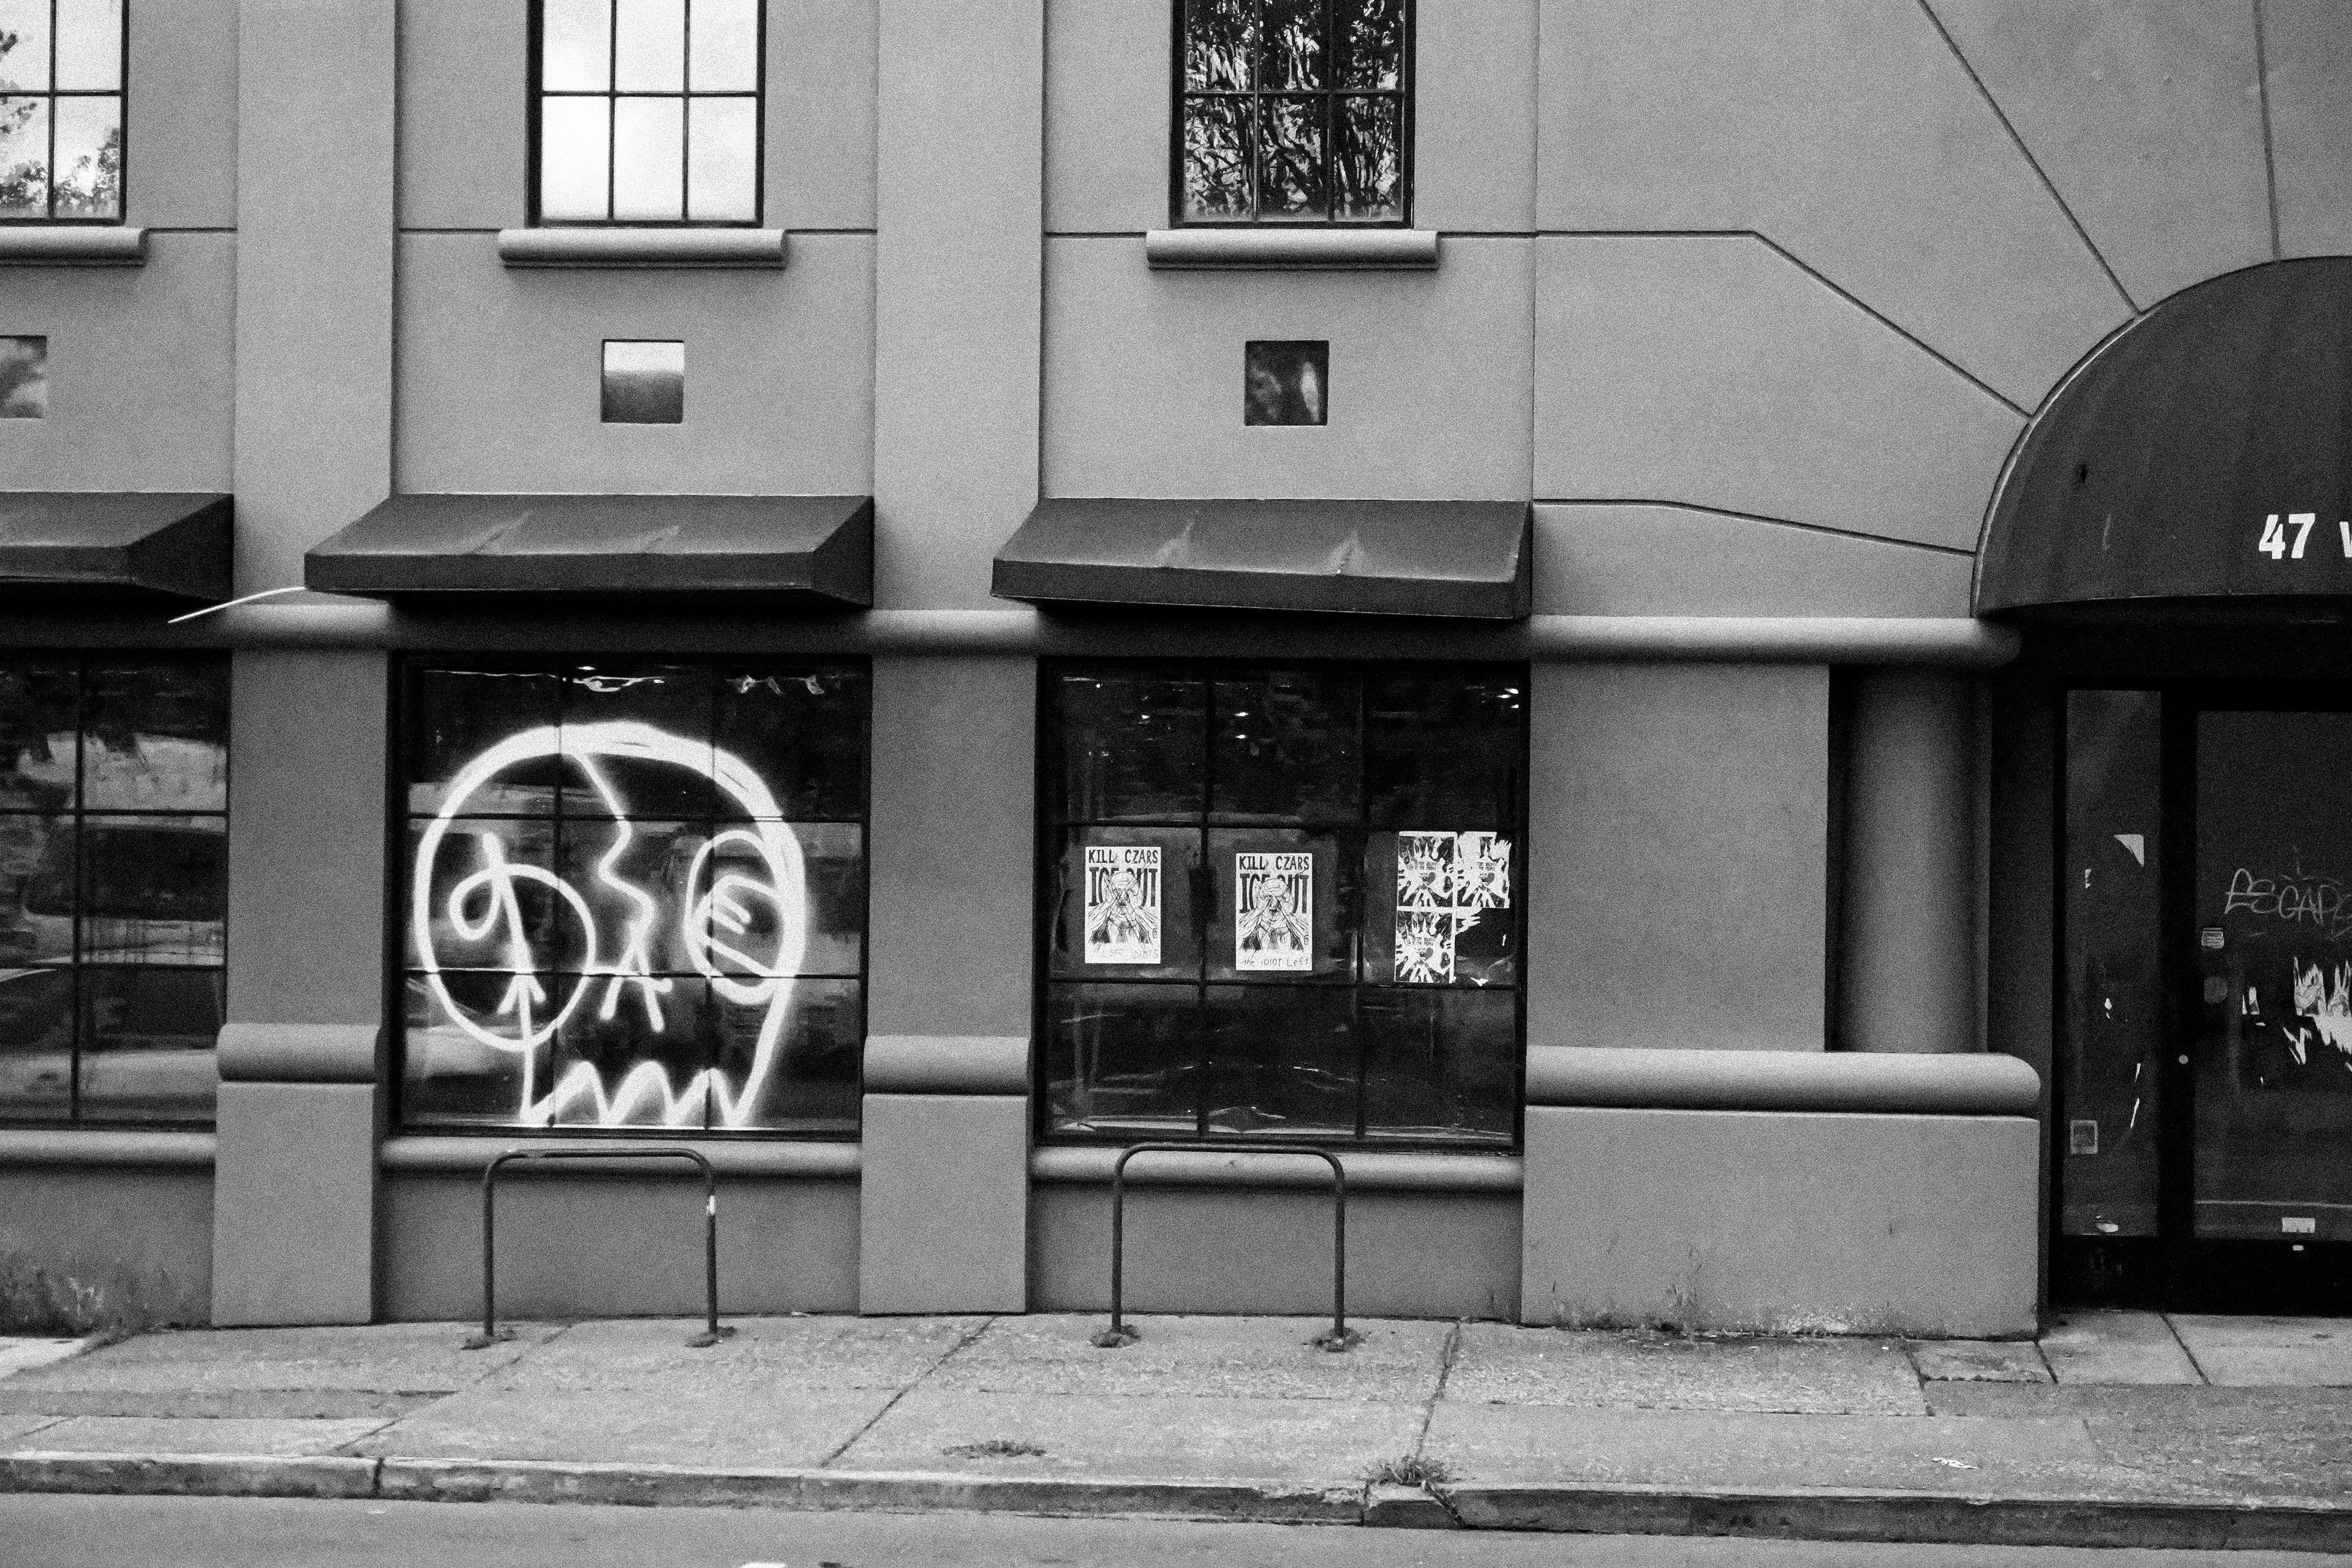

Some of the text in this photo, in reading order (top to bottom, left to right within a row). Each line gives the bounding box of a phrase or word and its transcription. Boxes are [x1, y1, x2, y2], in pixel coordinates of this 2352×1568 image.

[2259, 513, 2315, 559] 47
[1088, 849, 1158, 864] KILL CZARS
[1239, 856, 1310, 870] KILL CZARS
[1126, 867, 1158, 907] UT
[1276, 874, 1310, 914] UT
